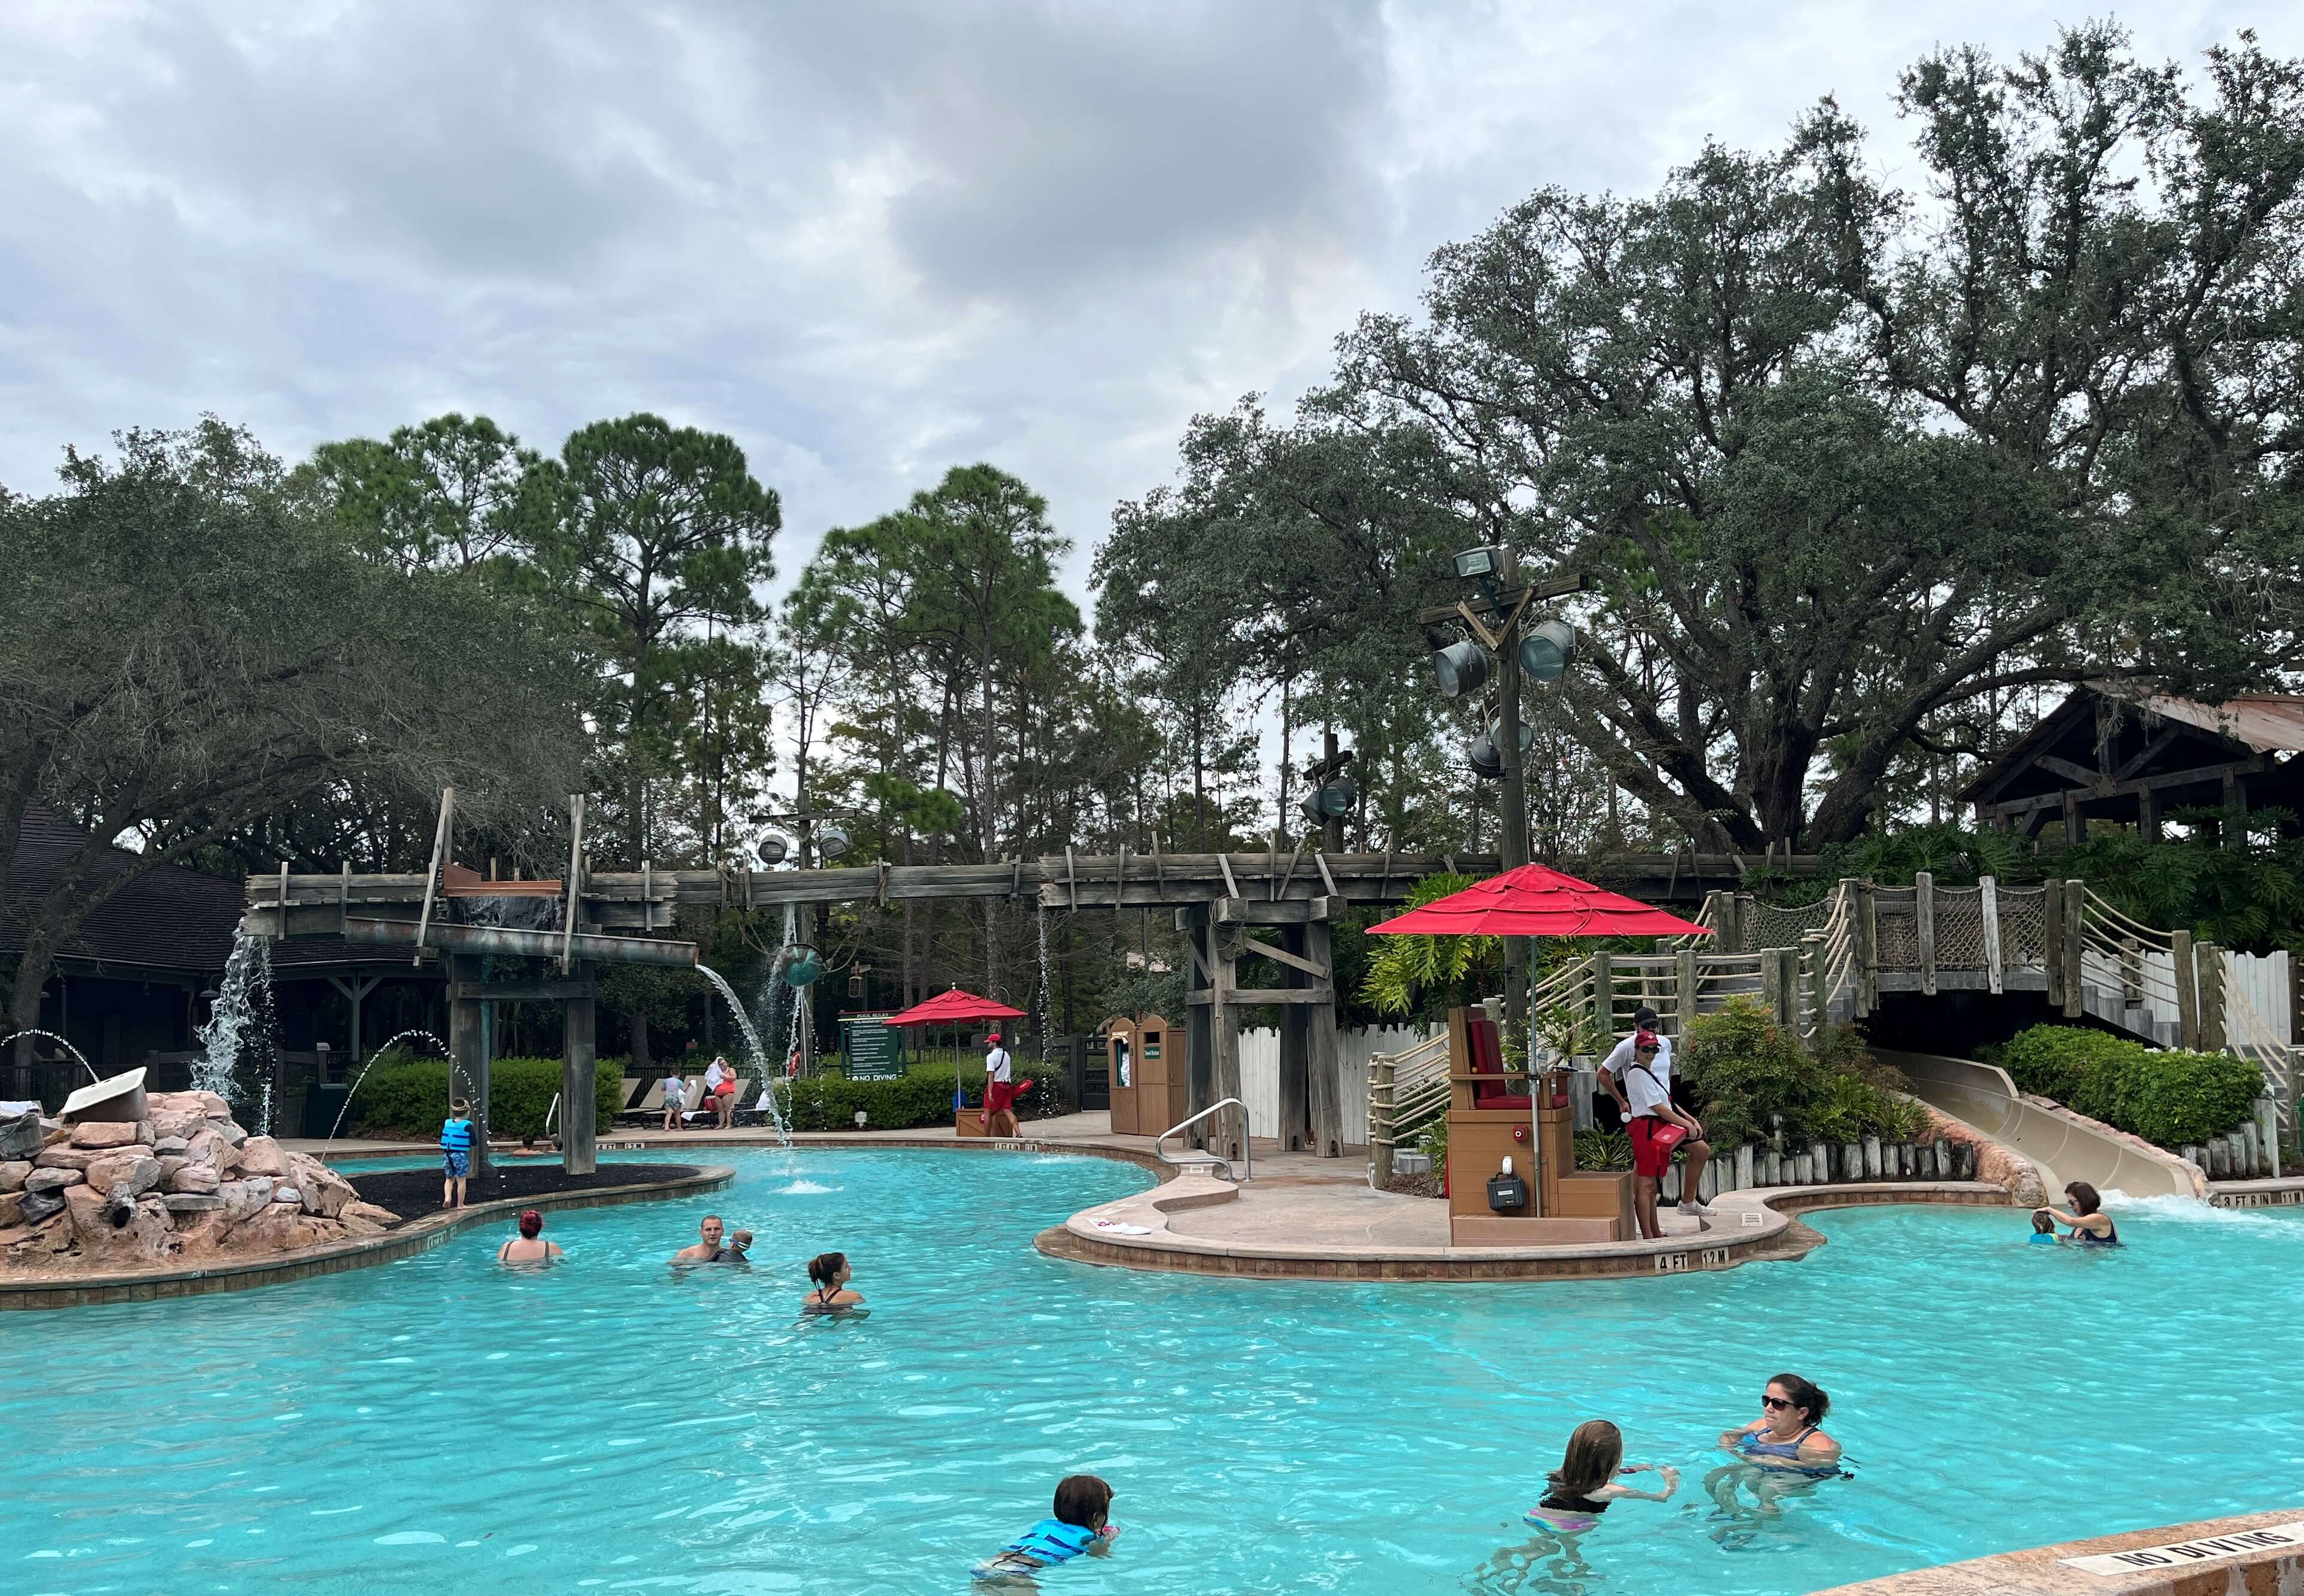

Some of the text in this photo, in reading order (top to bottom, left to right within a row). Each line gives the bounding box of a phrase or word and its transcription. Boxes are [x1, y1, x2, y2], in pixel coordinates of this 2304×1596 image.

[2224, 1194, 2269, 1206] 3 FT 6 IN
[1660, 1254, 1686, 1270] 4 FT
[2112, 1532, 2296, 1567] NO DIVING
